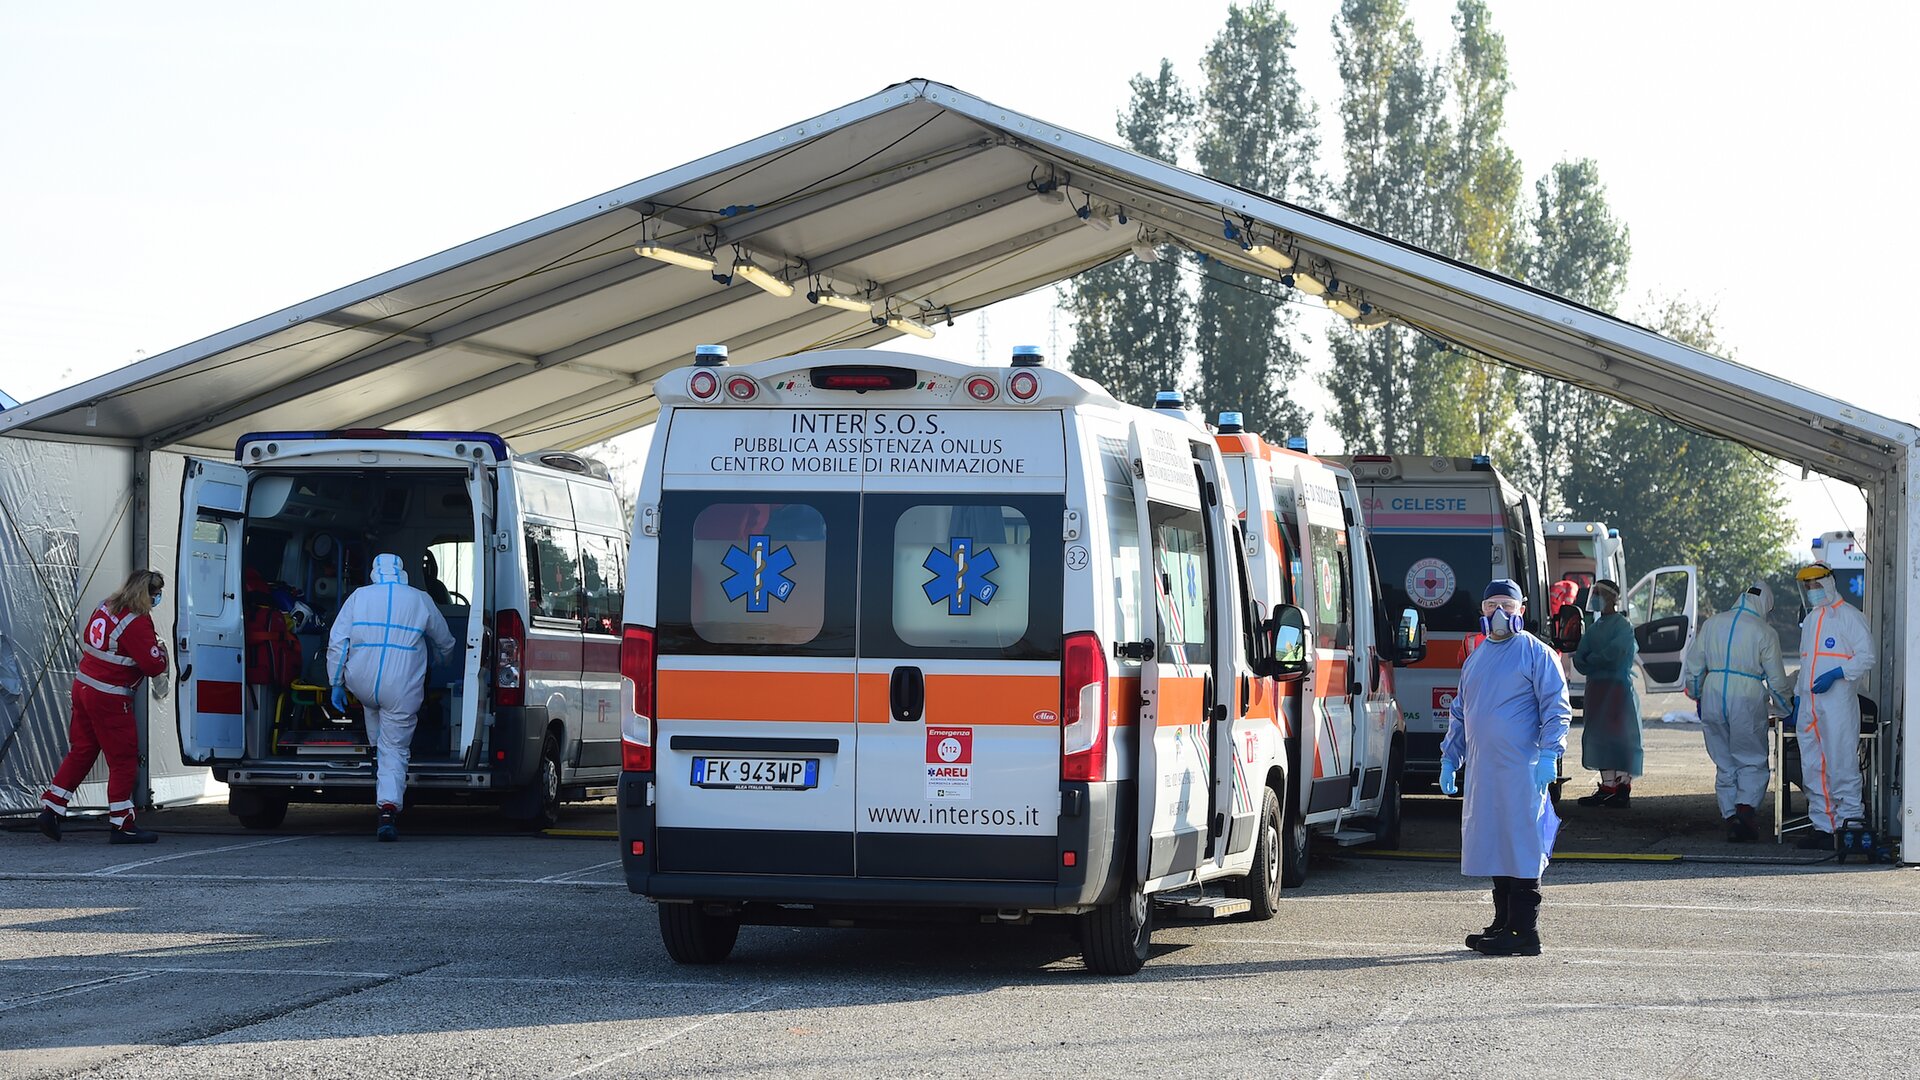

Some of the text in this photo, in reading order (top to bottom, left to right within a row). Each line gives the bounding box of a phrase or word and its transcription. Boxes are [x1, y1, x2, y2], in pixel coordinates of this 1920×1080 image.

[792, 413, 946, 435] INTER S.O.S.
[734, 437, 1003, 454] PUBBLICA ASSISTENZA ONLUS
[710, 456, 1025, 474] CENTRO MOBILE DI RIANIMAZIONE
[1362, 498, 1466, 511] SA CELESTE
[1068, 551, 1086, 565] 32
[1417, 598, 1444, 607] MILANO
[1403, 712, 1420, 720] PAS
[928, 729, 971, 737] Emergenza
[707, 761, 730, 782] FK
[740, 761, 803, 783] 943WP
[935, 768, 968, 777] AREU
[868, 803, 1039, 826] www.intersos.it
